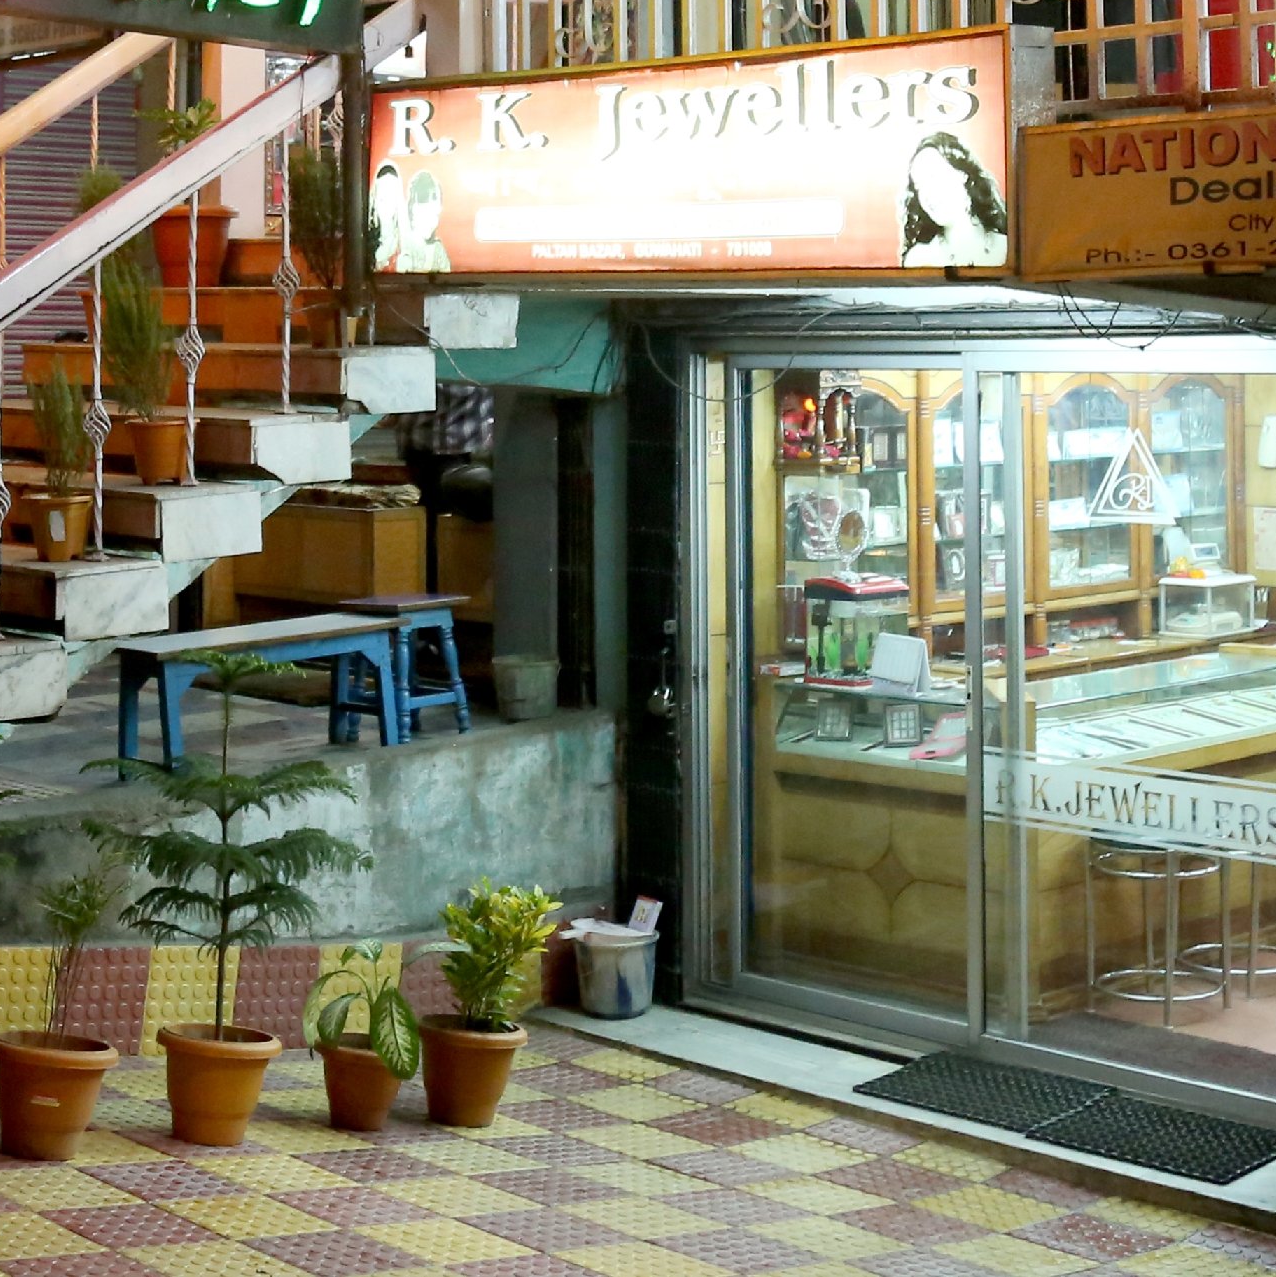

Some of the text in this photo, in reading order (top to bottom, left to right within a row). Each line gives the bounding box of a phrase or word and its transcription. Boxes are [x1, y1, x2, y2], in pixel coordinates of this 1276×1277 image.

[388, 60, 980, 161] R. K. Jewellers
[1228, 212, 1273, 234] City
